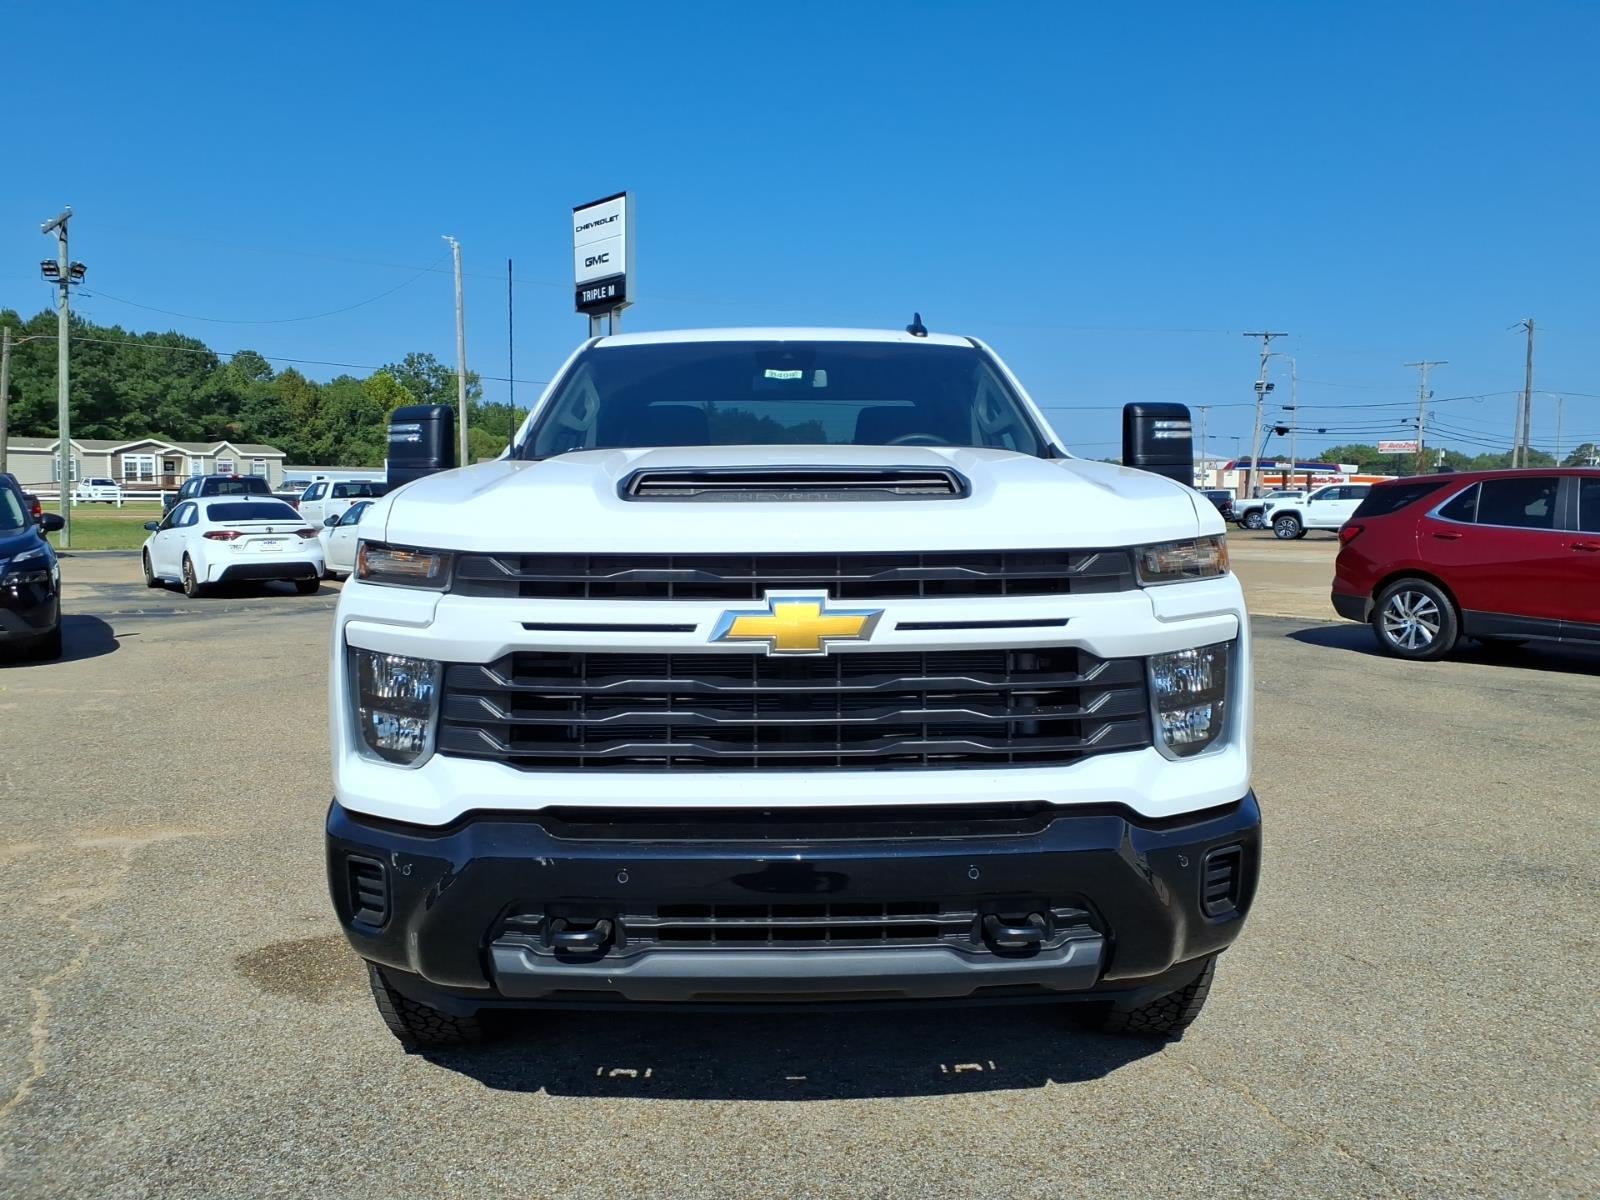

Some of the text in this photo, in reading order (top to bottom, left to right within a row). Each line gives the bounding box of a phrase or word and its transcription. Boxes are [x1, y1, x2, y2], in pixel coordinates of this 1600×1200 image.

[576, 215, 619, 232] CHEVROLET
[585, 253, 609, 268] GMC
[582, 285, 615, 302] TRIPLE M
